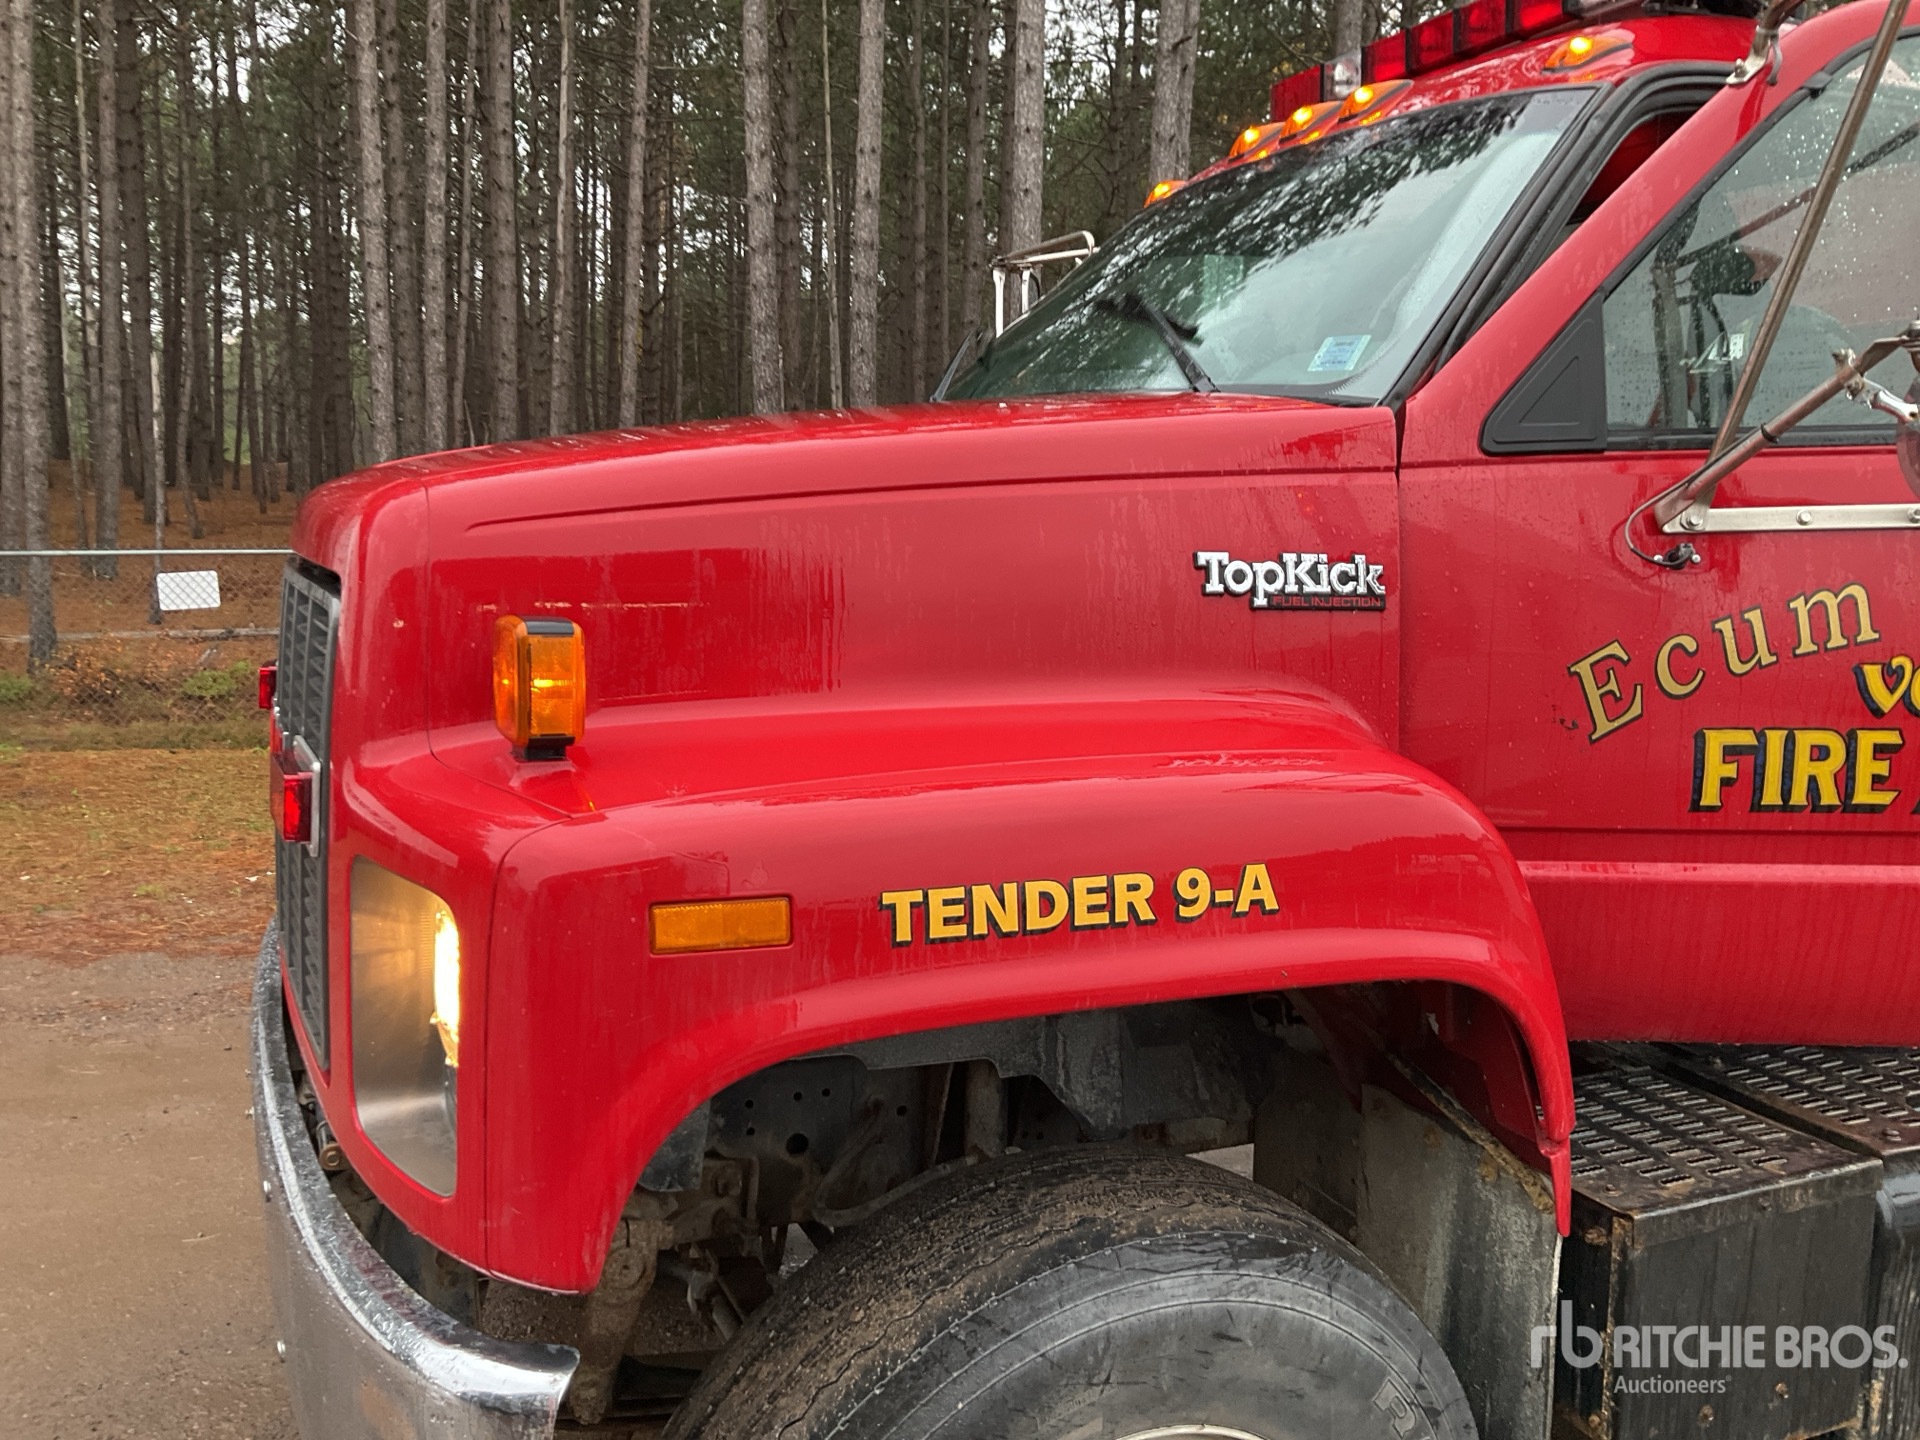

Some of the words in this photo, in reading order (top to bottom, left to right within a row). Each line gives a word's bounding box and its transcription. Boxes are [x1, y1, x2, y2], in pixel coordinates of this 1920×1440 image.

[1194, 551, 1386, 608] TopKick
[1272, 595, 1309, 607] FUEL
[1311, 596, 1381, 607] INJECTION
[1567, 581, 1881, 744] Ecum
[1688, 728, 1905, 813] FIRE
[879, 872, 1156, 948] TENDER
[1175, 863, 1279, 922] 9-A
